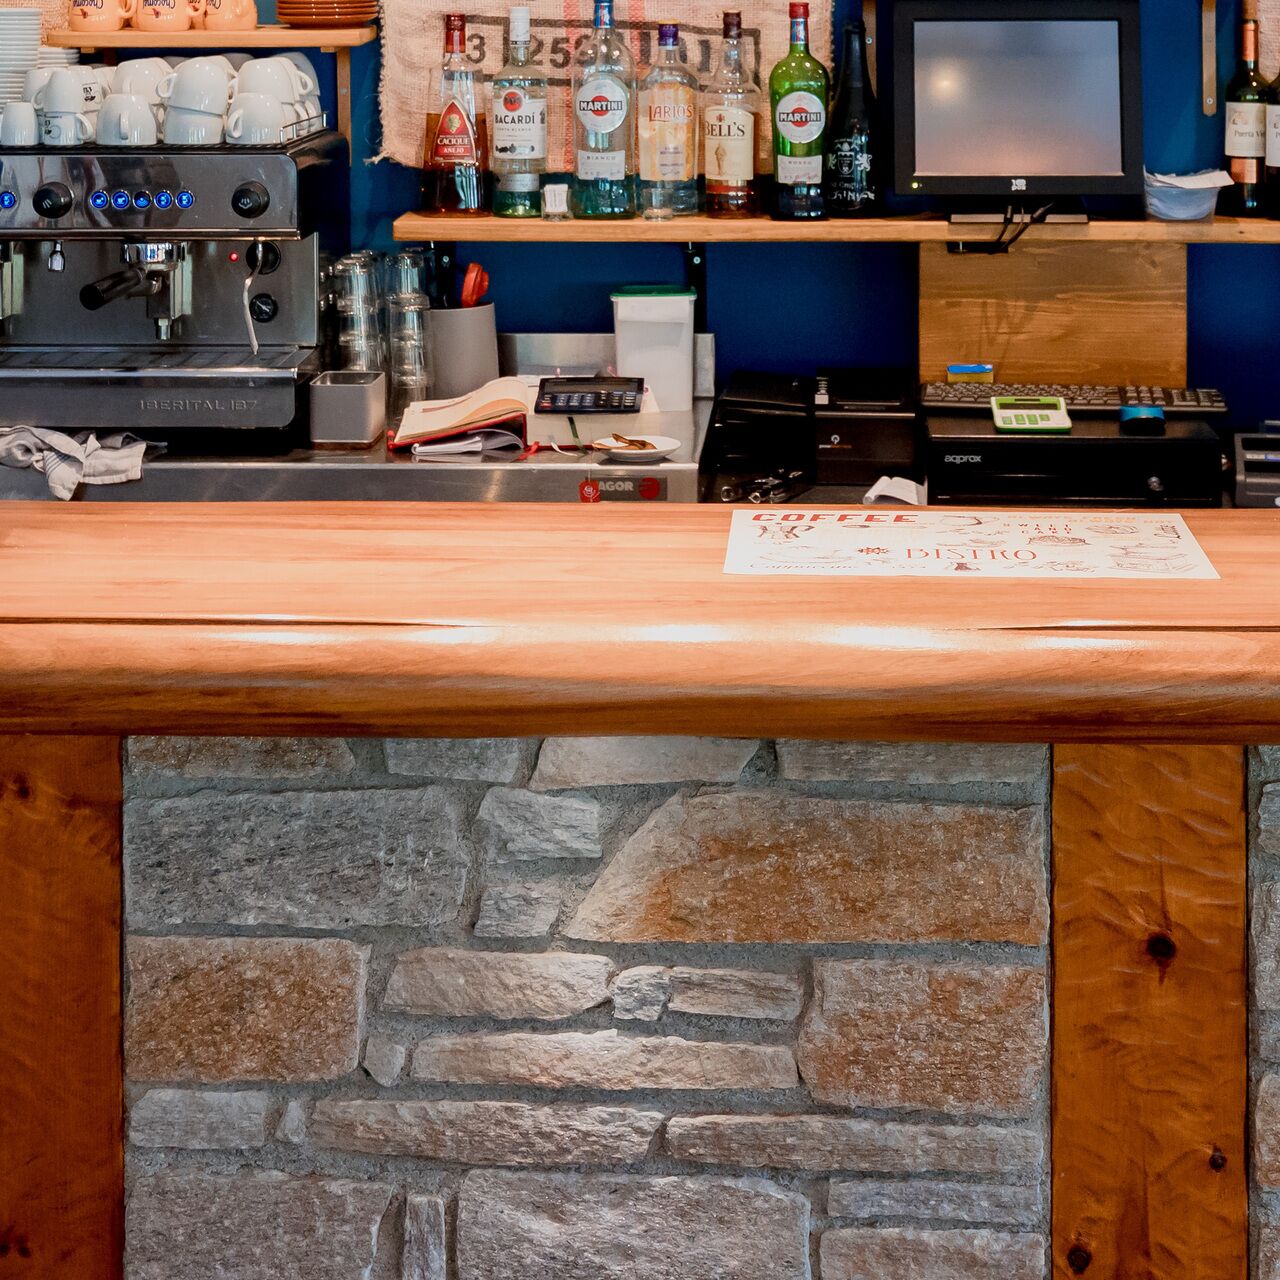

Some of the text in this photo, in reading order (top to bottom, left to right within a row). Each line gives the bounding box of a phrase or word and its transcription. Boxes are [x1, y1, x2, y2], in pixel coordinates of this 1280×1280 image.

[579, 101, 623, 111] MARTINI
[495, 112, 535, 125] BACARDÍ
[649, 104, 694, 122] LARIOS
[779, 112, 821, 122] MARTINI
[705, 121, 745, 137] BELL'S
[437, 137, 470, 146] CACIQUE
[139, 399, 225, 411] IBERITAL
[599, 481, 634, 491] AGOR
[752, 513, 919, 523] COFFEE
[906, 548, 1038, 561] BISTRO
